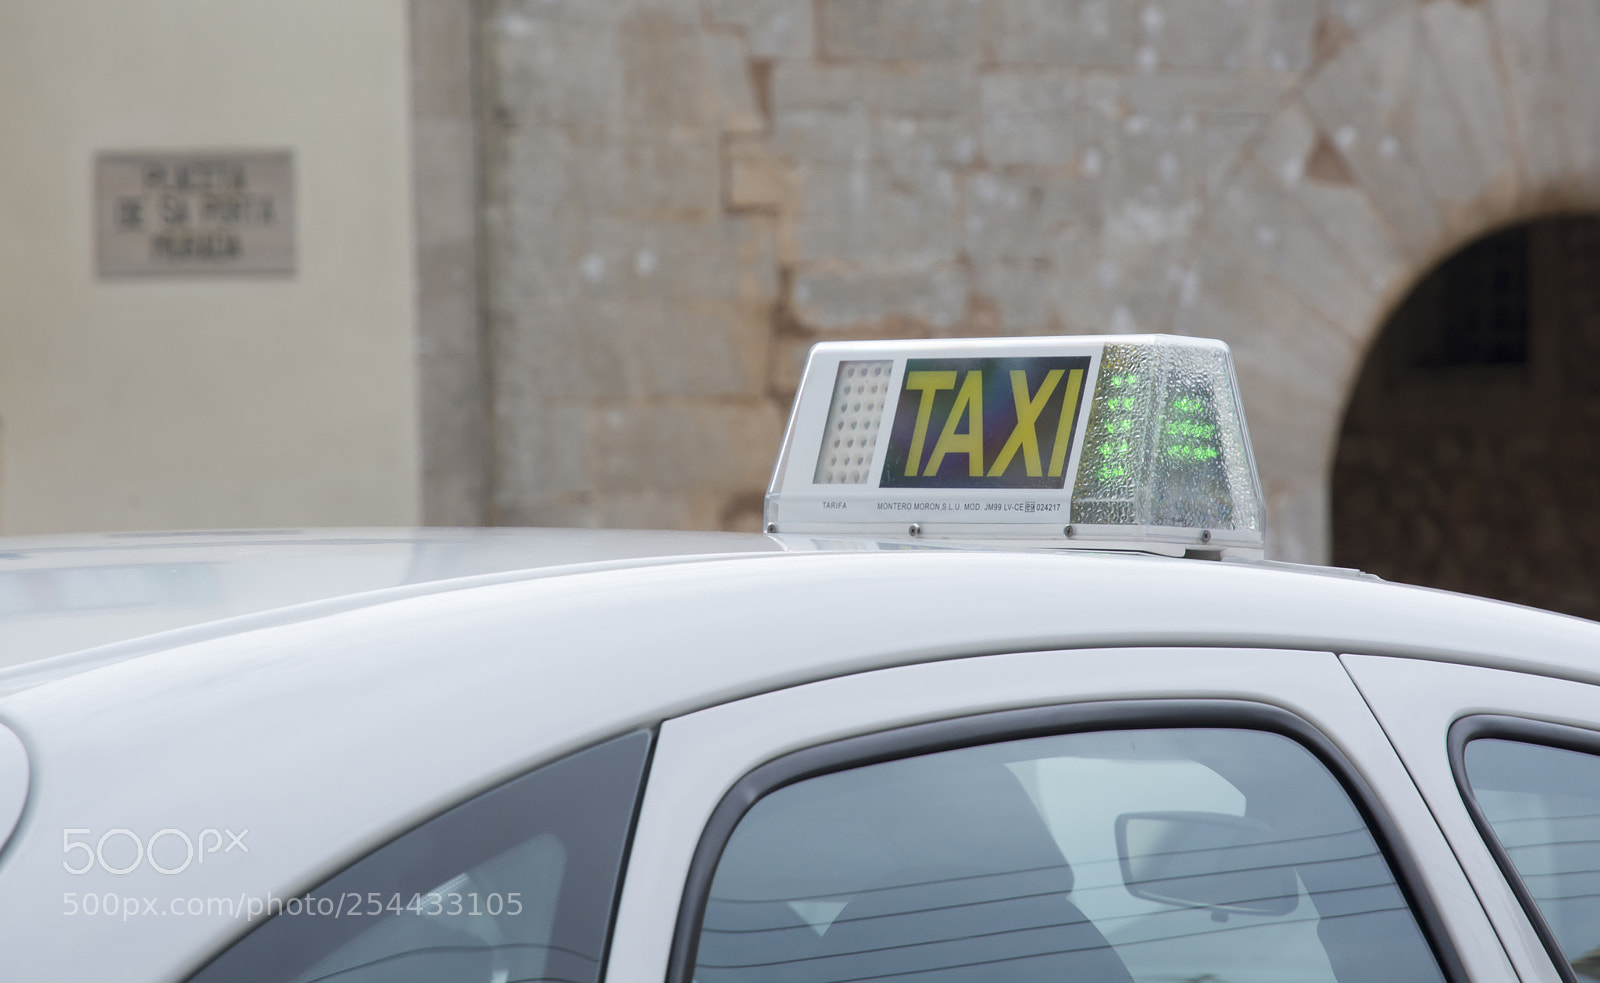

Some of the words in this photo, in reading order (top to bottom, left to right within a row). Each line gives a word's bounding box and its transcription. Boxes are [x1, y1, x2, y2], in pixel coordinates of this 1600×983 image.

[904, 369, 1084, 478] TAXI
[822, 501, 848, 511] TARIFA
[876, 502, 912, 511] MONTERO
[983, 502, 1002, 511] JM99
[1003, 502, 1024, 512] LV-CE
[1036, 503, 1061, 512] 024217
